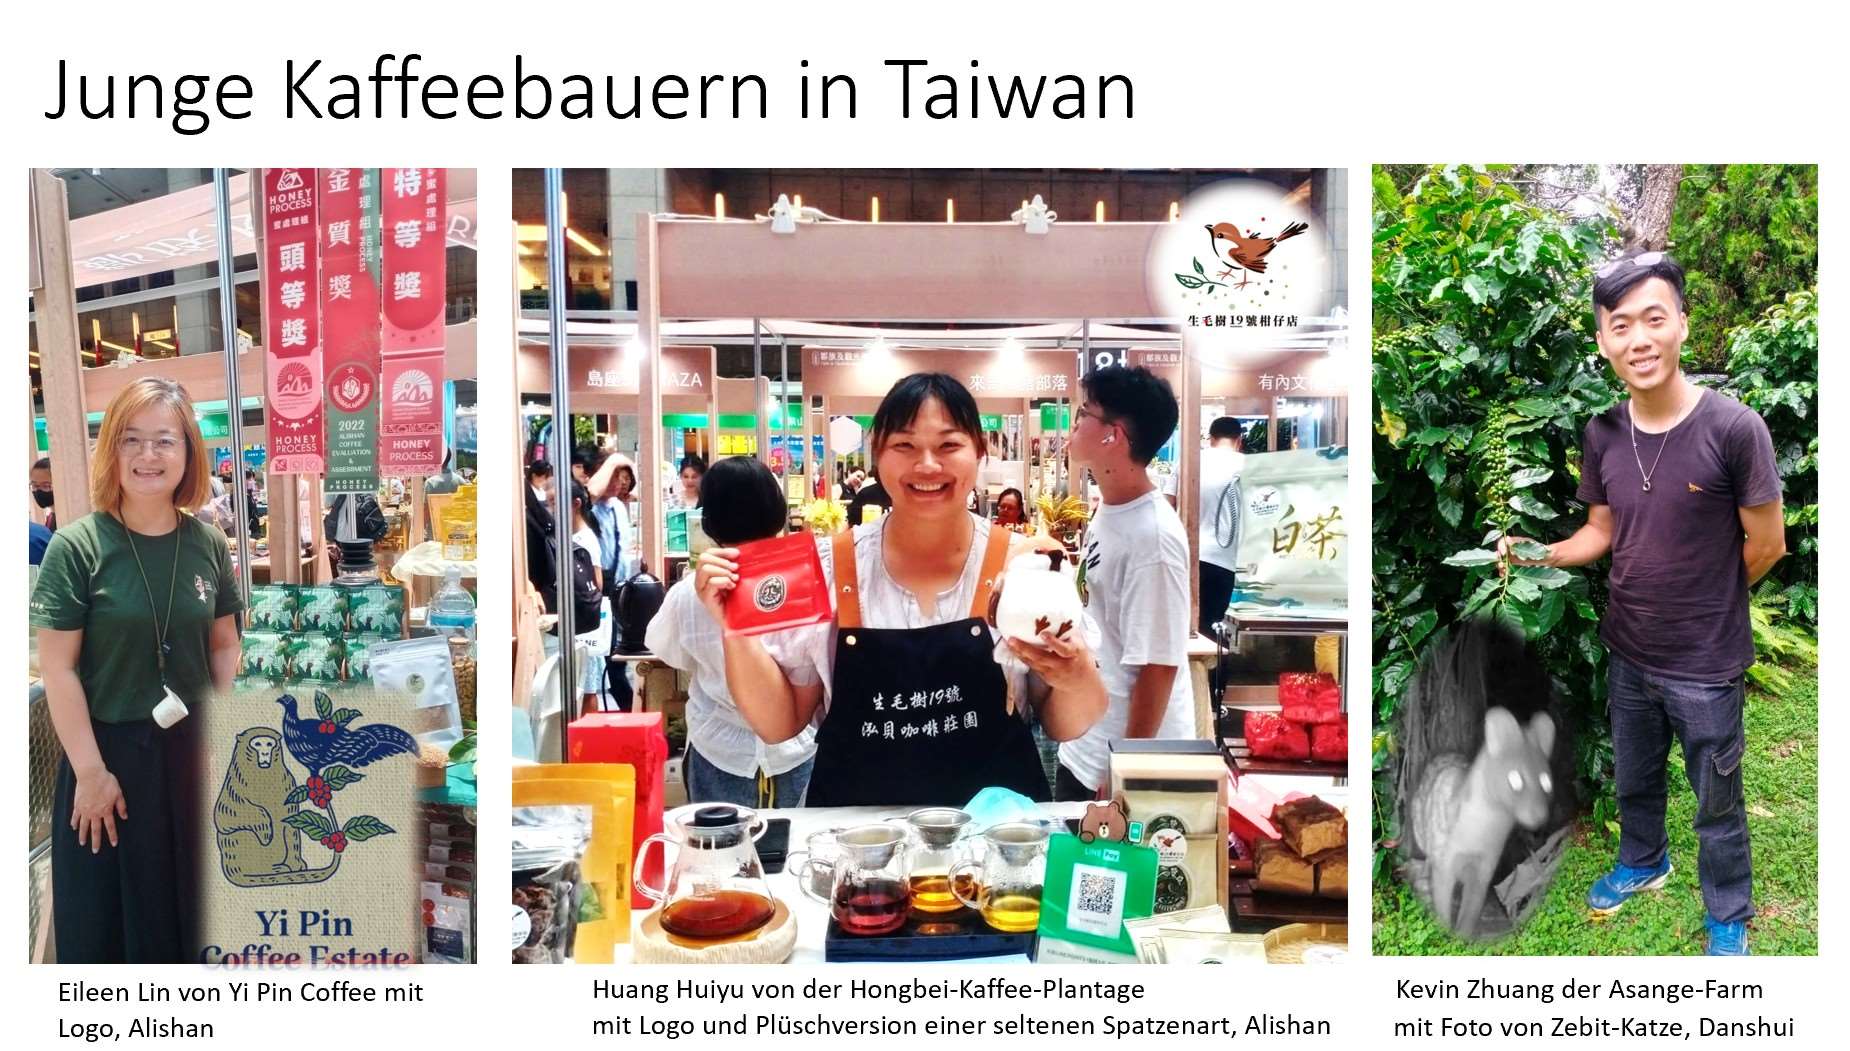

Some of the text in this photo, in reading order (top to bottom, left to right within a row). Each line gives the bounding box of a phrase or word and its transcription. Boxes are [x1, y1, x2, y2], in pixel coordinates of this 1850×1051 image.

[269, 188, 312, 205] HONEY
[358, 168, 372, 231] 處理組
[270, 198, 312, 214] PROCESS
[279, 241, 306, 348] 頭等獎
[338, 419, 365, 431] 2022
[275, 434, 317, 445] HONEY
[338, 440, 362, 448] COFFEE
[392, 439, 431, 449] HONEY
[276, 443, 317, 454] PROCESS
[331, 449, 371, 457] EVALUATION
[389, 451, 434, 461] PROCESS
[1272, 504, 1347, 560] 白茶
[872, 685, 963, 711] 生毛樹19號
[1103, 849, 1119, 861] Pay
